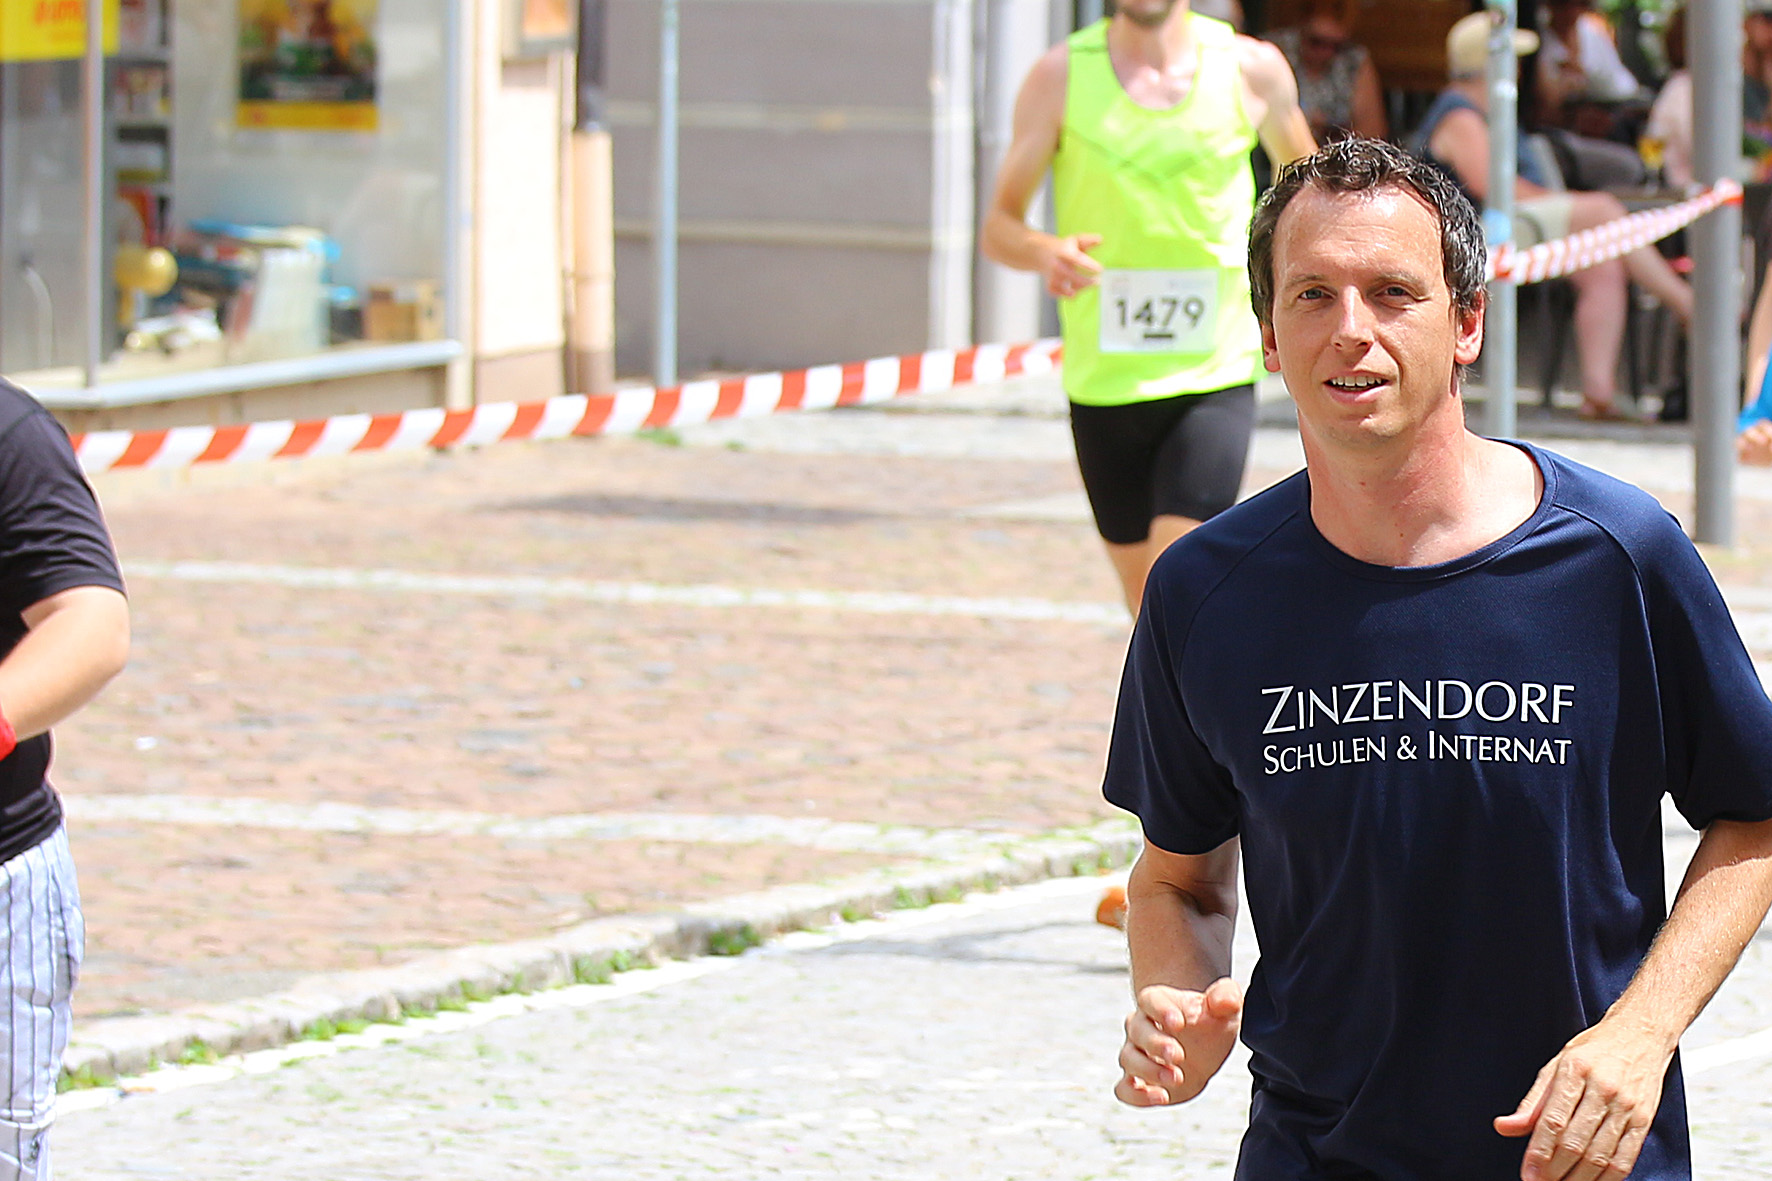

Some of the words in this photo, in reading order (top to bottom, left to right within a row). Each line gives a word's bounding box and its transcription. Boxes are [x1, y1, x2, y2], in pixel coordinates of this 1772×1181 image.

[1115, 297, 1205, 330] 1479
[1261, 679, 1575, 735] ZINZENDORF
[1262, 736, 1386, 775] SCHULEN
[1396, 734, 1418, 761] &
[1428, 730, 1572, 765] INTERNAT
